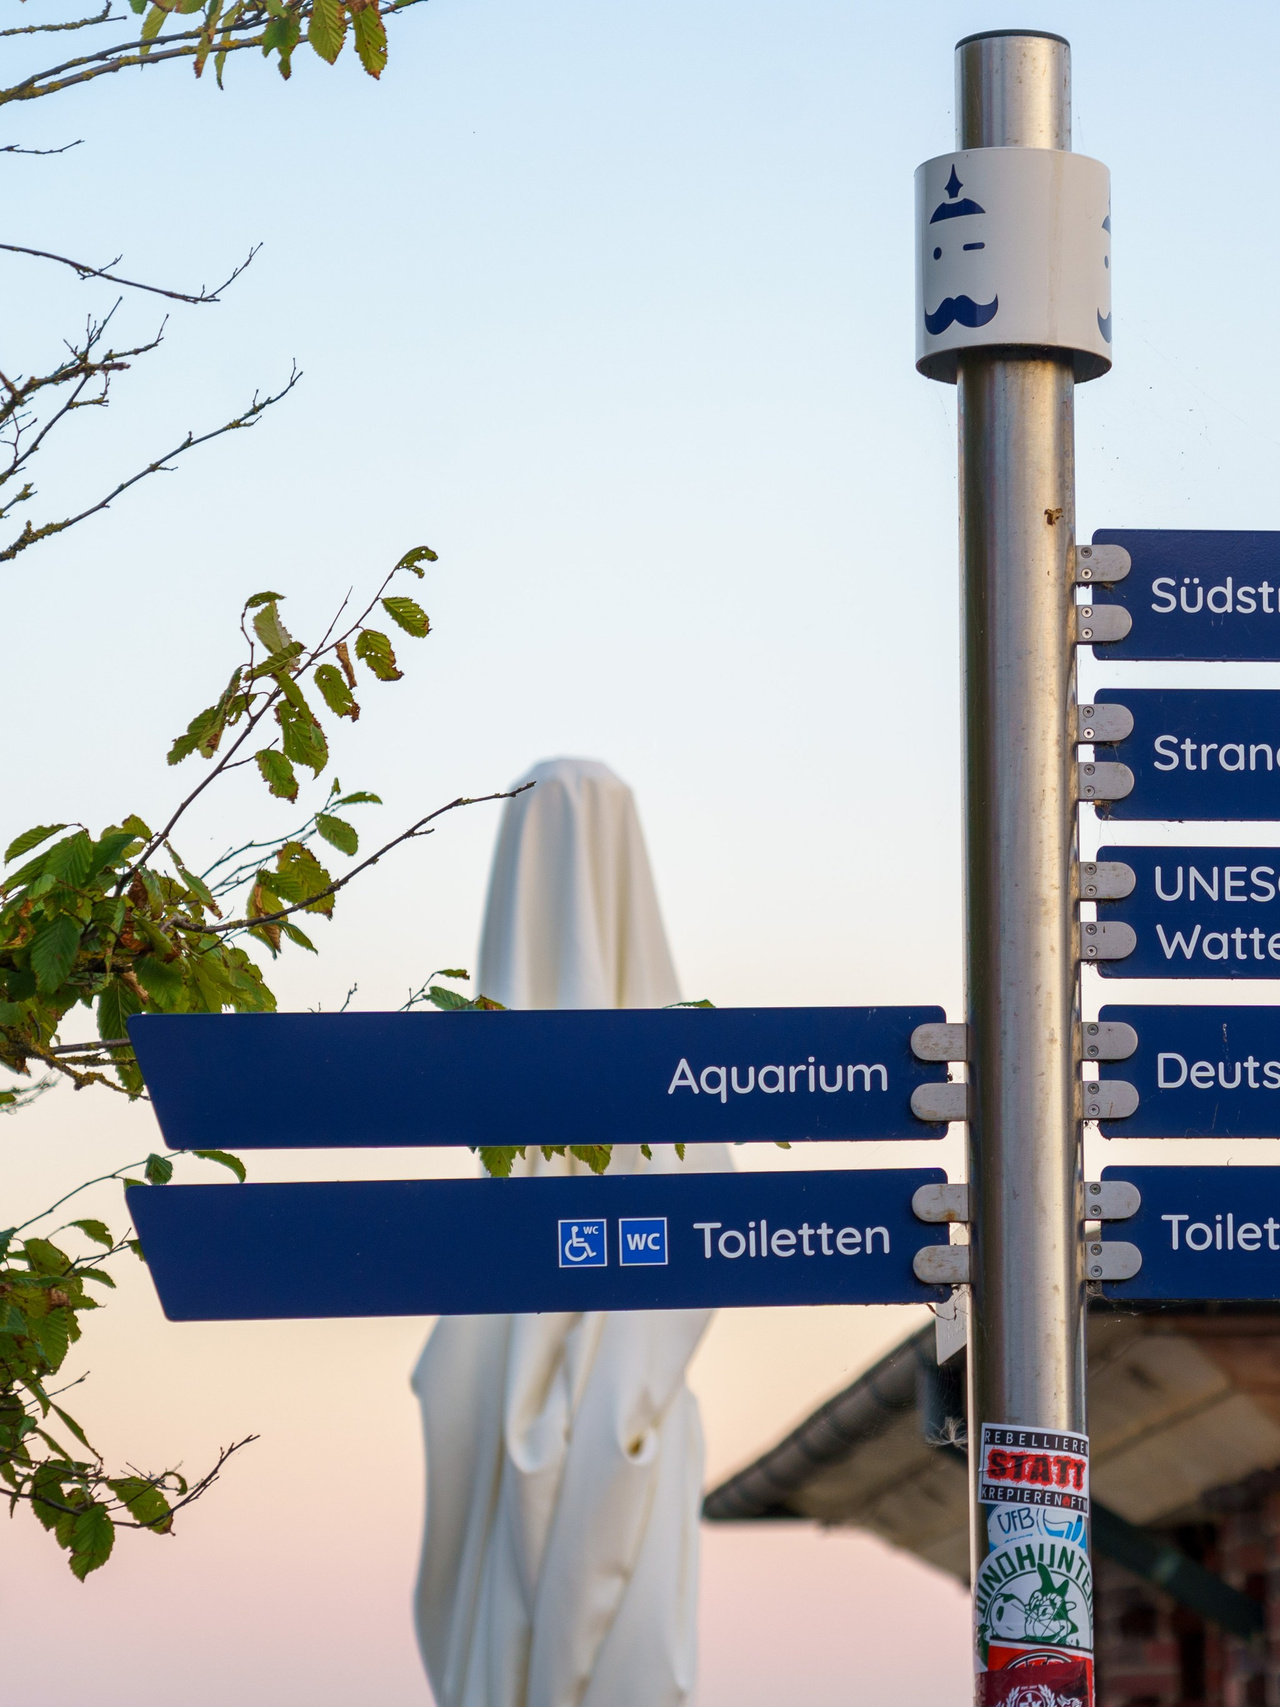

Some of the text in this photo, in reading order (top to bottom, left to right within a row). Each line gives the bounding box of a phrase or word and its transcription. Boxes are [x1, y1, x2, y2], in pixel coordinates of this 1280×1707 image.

[667, 1056, 888, 1104] Aquarium
[582, 1225, 599, 1235] WC
[626, 1232, 661, 1251] WC
[692, 1219, 890, 1259] Toiletten
[988, 1449, 1085, 1489] STATT
[982, 1487, 1062, 1507] KREPIEREN
